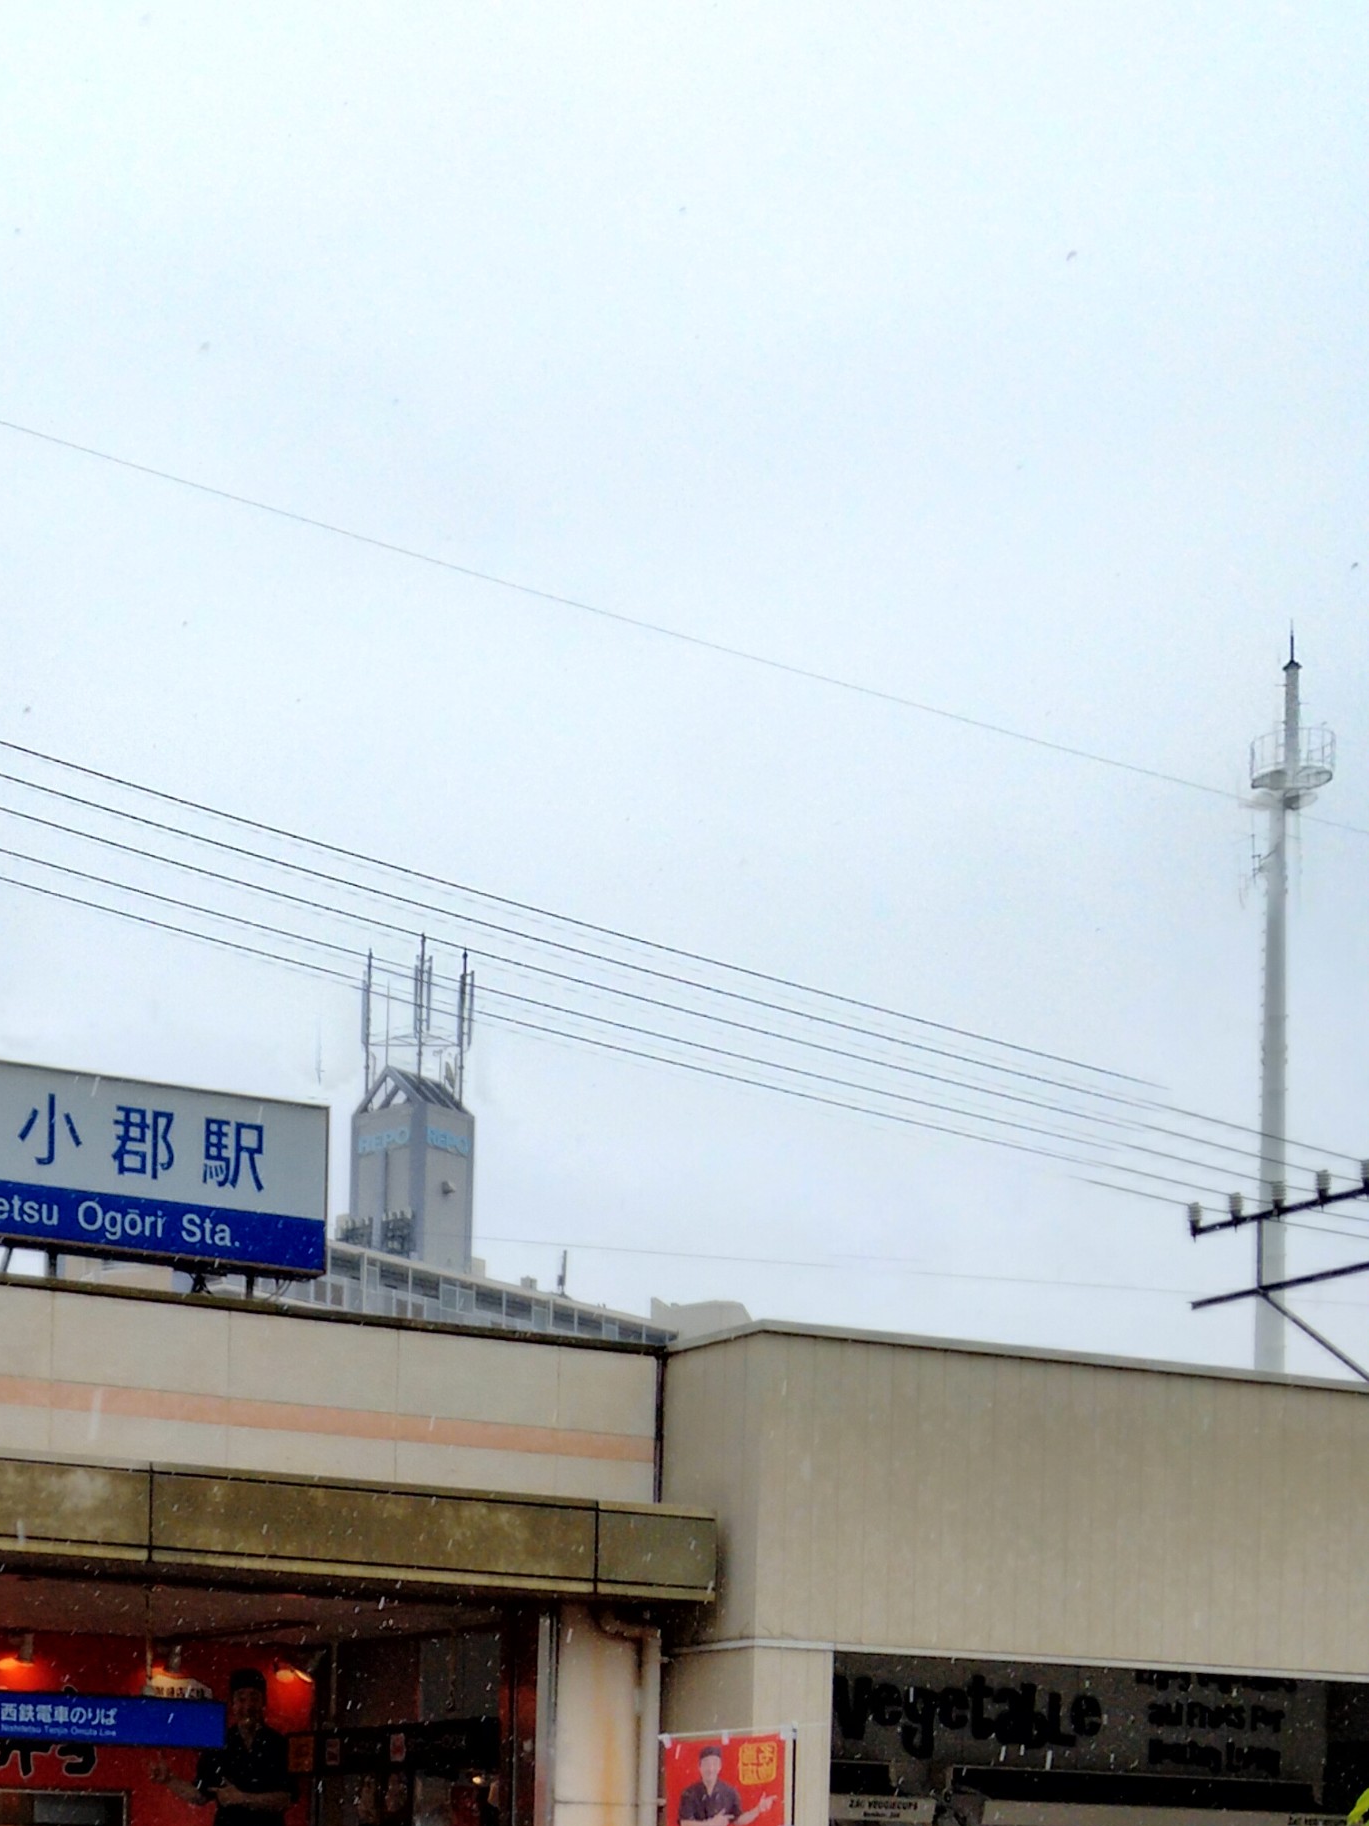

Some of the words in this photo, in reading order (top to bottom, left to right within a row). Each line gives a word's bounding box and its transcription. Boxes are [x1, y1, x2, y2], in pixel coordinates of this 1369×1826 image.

[77, 1200, 166, 1242] Ogōri
[182, 1213, 241, 1248] Sta.
[0, 1702, 118, 1726] 西鉄電車のりば
